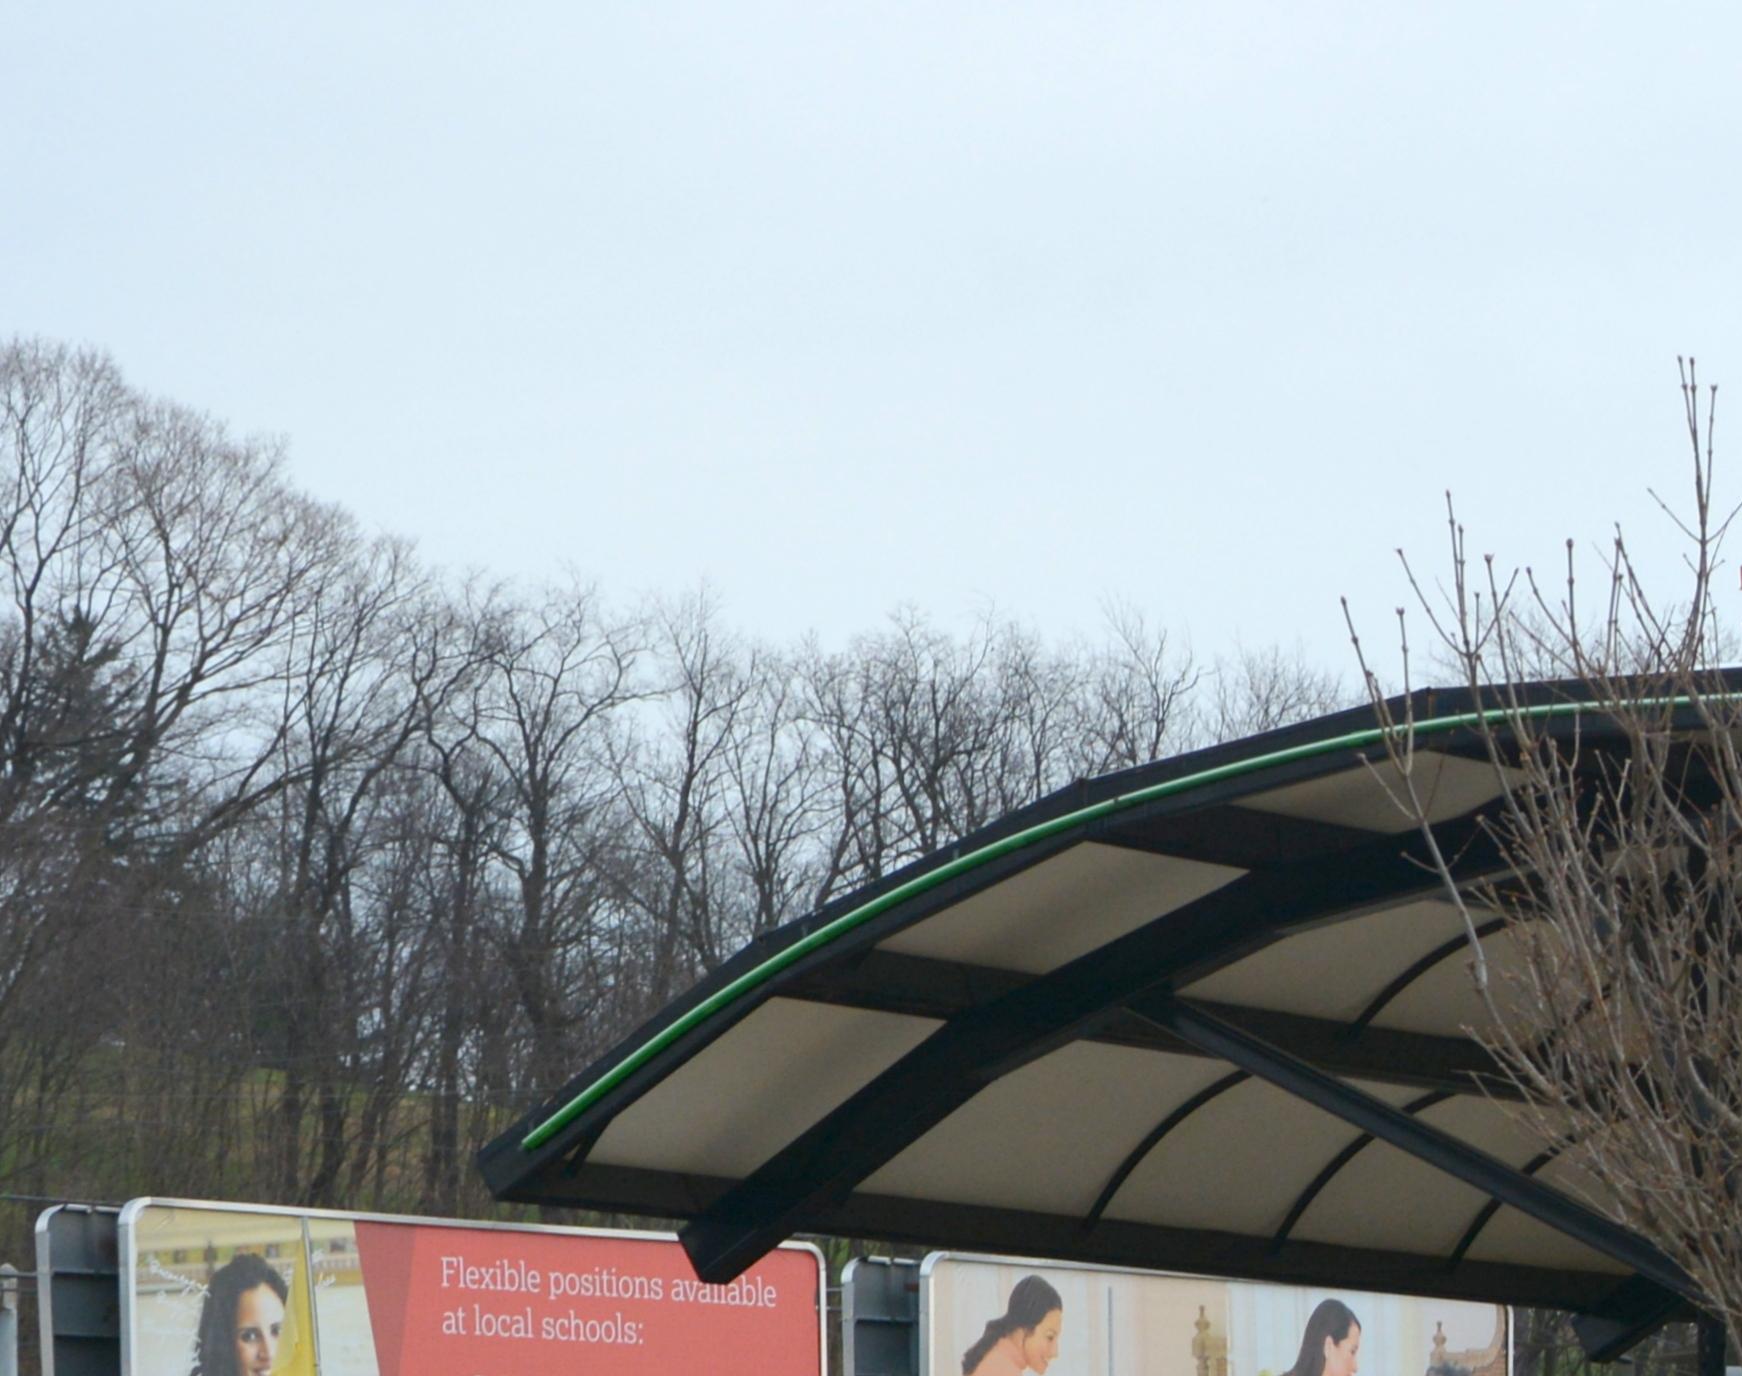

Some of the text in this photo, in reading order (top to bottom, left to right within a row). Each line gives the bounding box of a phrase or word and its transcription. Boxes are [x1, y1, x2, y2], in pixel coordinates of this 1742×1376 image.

[441, 1256, 777, 1308] Flexible positions available
[442, 1304, 644, 1345] at local schools:
